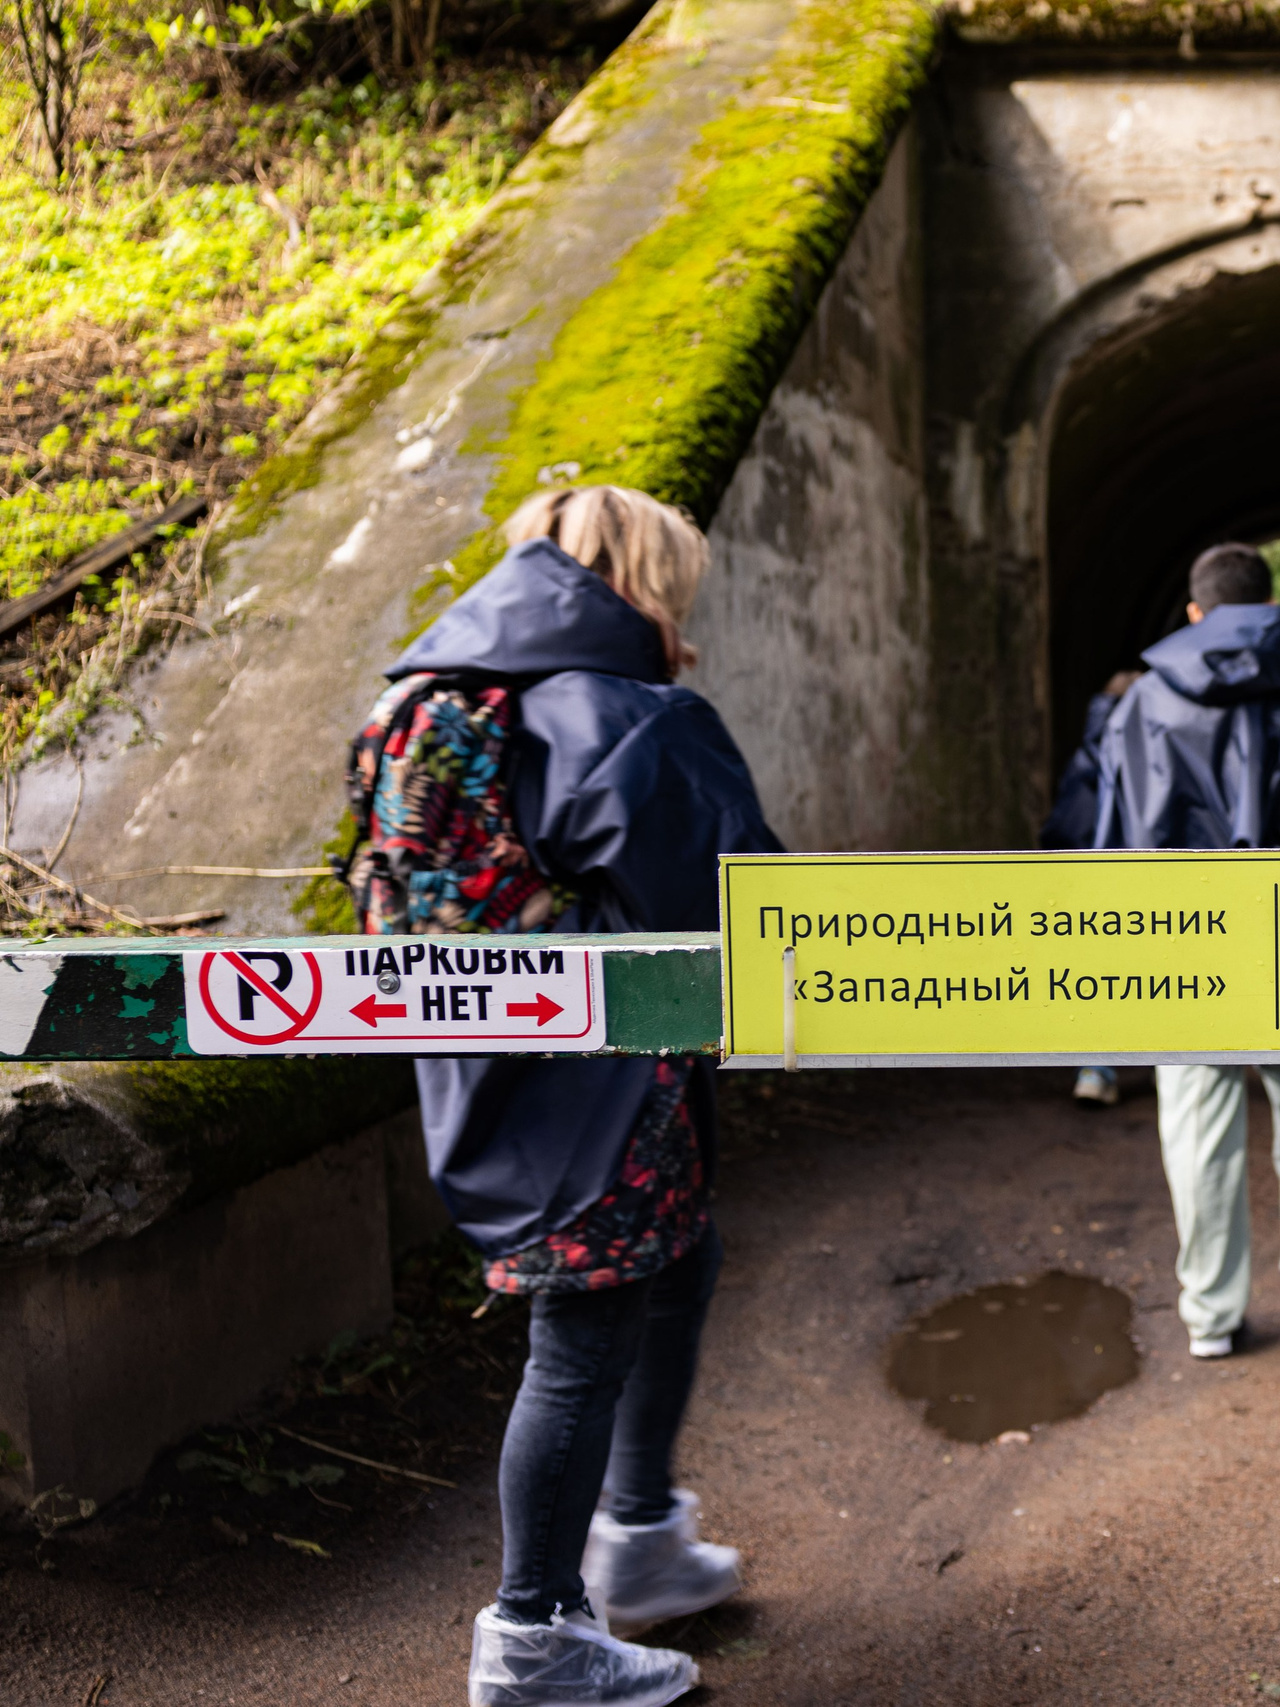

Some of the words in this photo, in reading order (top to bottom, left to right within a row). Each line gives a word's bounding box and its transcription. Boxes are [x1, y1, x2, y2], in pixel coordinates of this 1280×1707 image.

[759, 901, 1012, 947] Природный
[1030, 910, 1227, 937] заказник
[421, 985, 496, 1021] НЕТ
[793, 966, 1029, 1010] «Западный
[1049, 968, 1226, 1001] Котлин»
